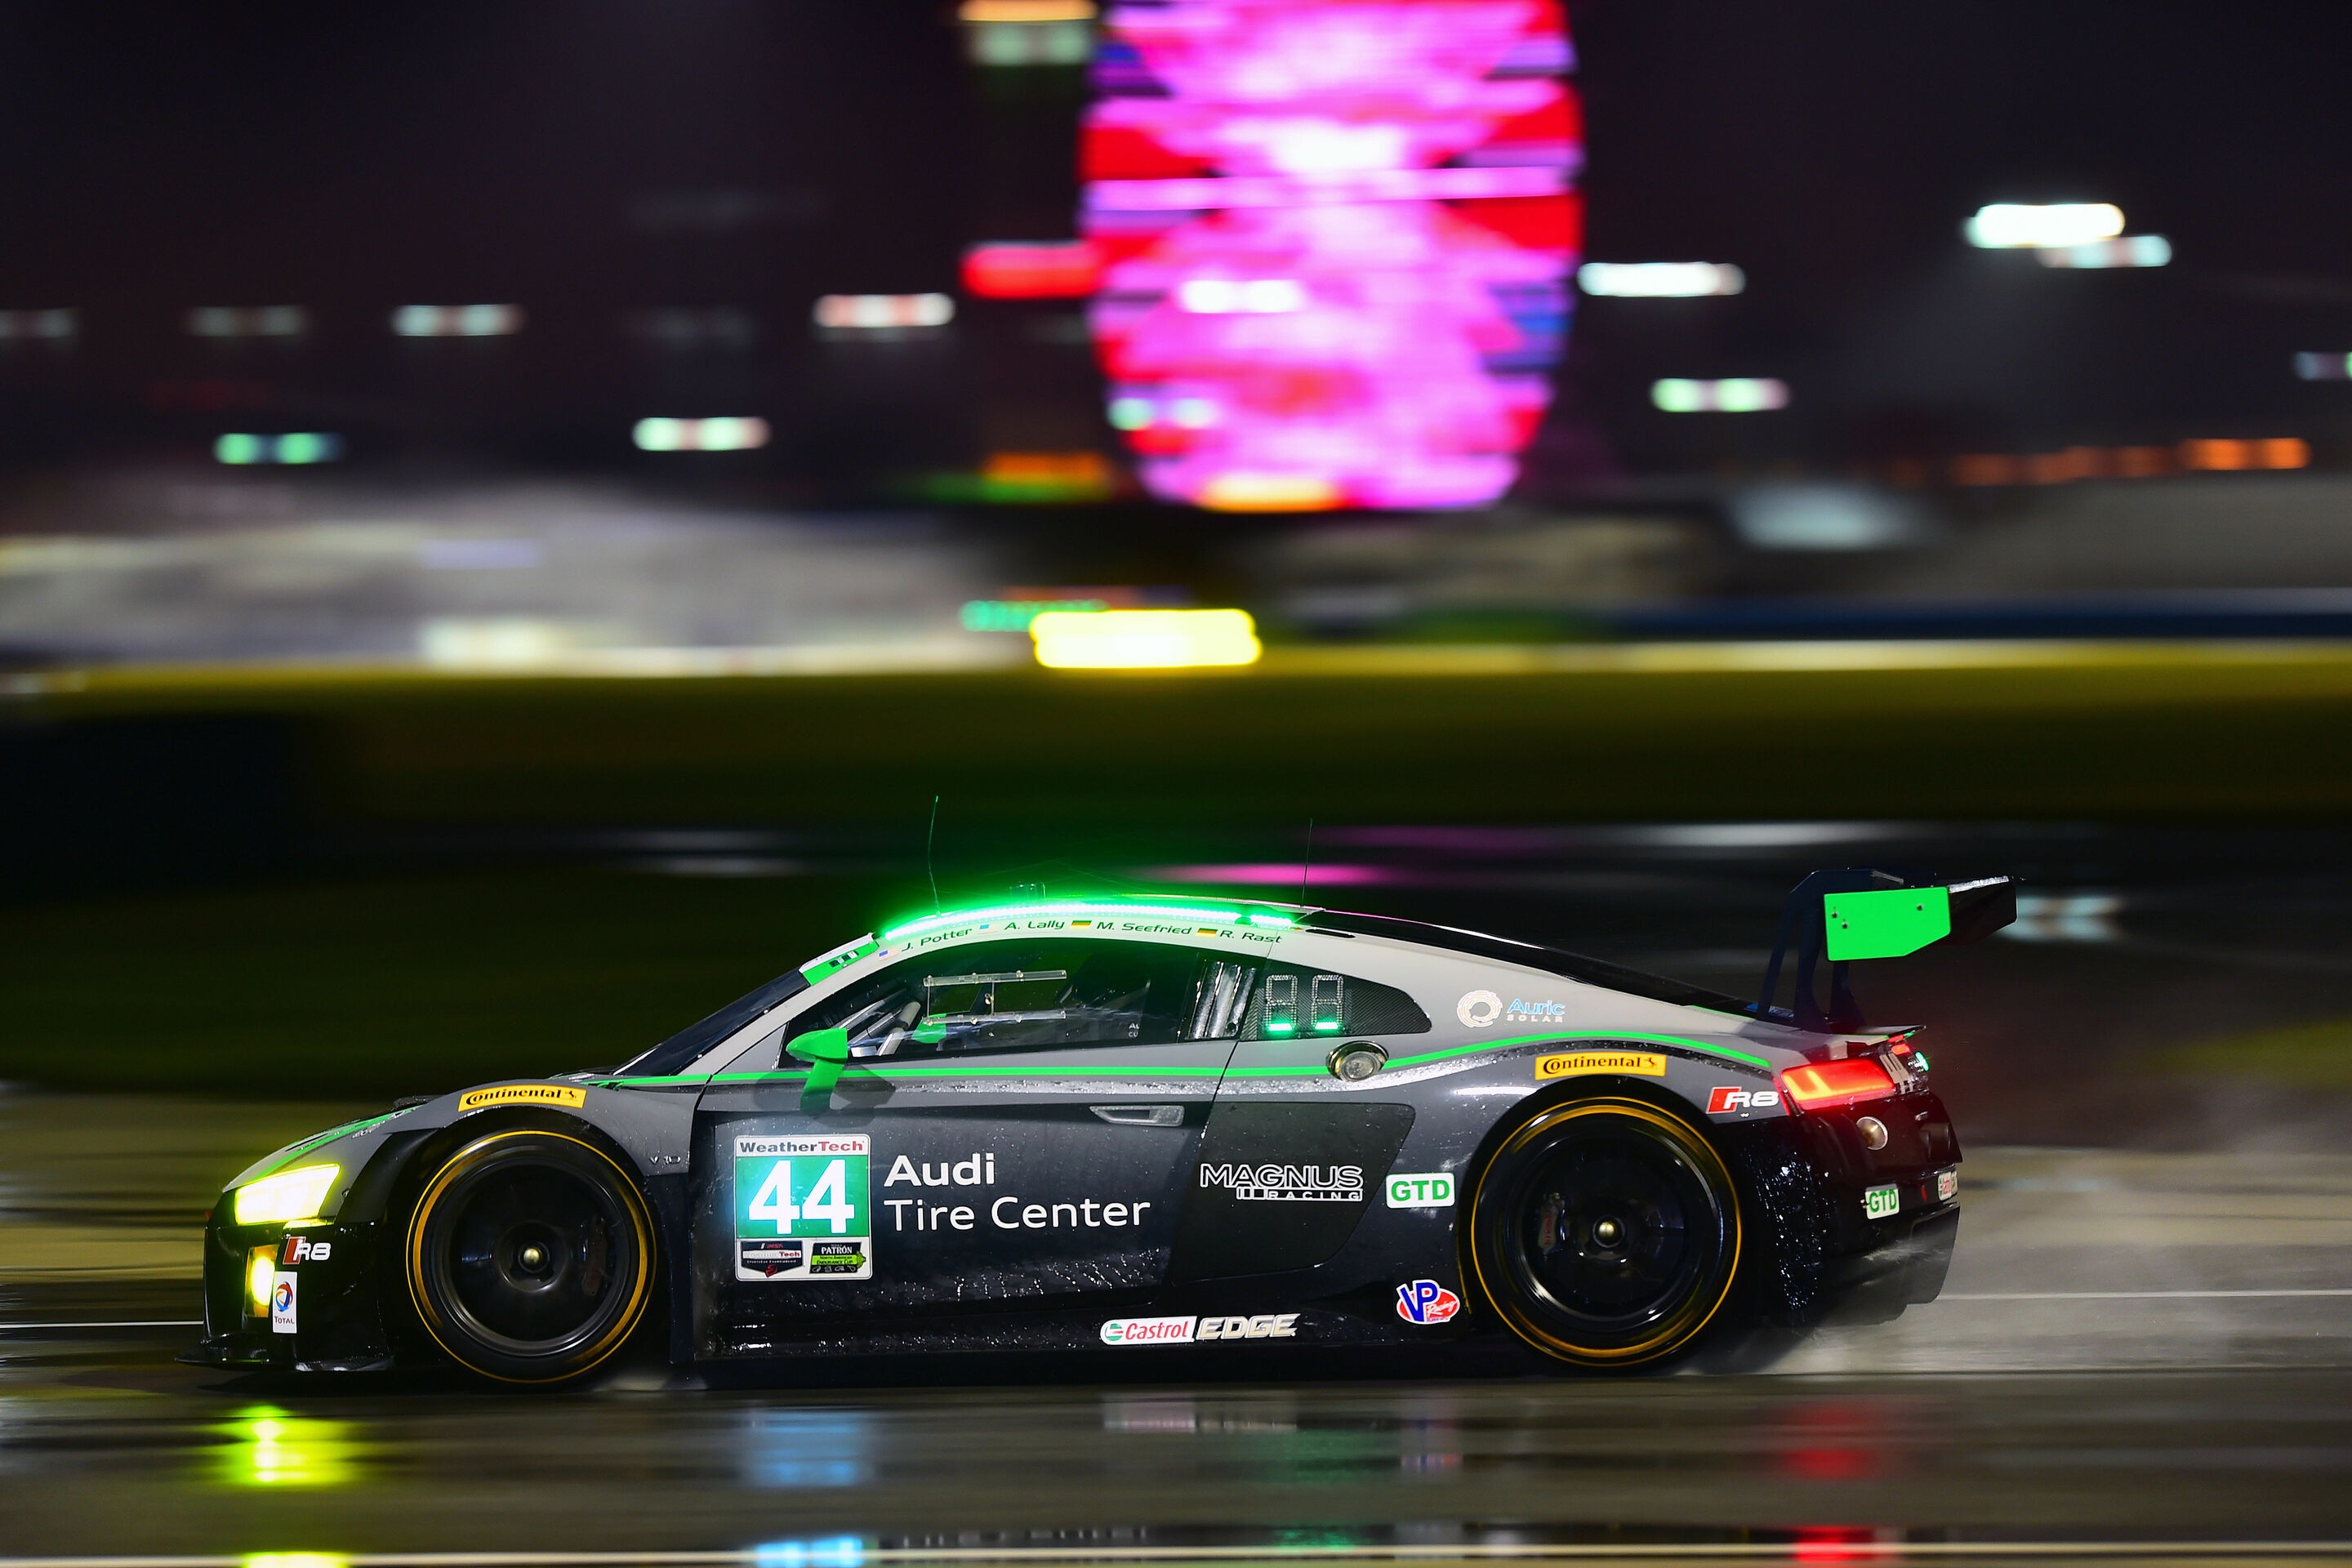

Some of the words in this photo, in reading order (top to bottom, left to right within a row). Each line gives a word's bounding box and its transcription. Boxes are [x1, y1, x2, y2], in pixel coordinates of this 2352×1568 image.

[901, 942, 914, 951] J.
[920, 928, 972, 946] Potter
[1004, 921, 1021, 929] A.
[1027, 920, 1065, 929] Lally
[1096, 921, 1115, 930] M.
[1121, 923, 1192, 934] Seefried
[1219, 929, 1235, 938] R.
[1241, 932, 1282, 943] Rast
[1506, 998, 1566, 1016] Auric
[1543, 1056, 1642, 1074] Continental
[466, 1088, 562, 1106] Continental
[1722, 1089, 1780, 1110] R8
[739, 1141, 864, 1152] WeatherTech
[884, 1152, 996, 1187] Audi
[1200, 1164, 1364, 1188] MAGNUS
[748, 1159, 855, 1234] 44
[1268, 1190, 1361, 1200] RACING
[1391, 1179, 1450, 1201] GTD
[1869, 1188, 1897, 1213] GTD
[884, 1198, 975, 1231] Tire
[991, 1196, 1151, 1229] Center
[292, 1241, 332, 1262] R8
[821, 1245, 853, 1254] PATRÓN
[1399, 1281, 1438, 1322] VP
[274, 1316, 295, 1325] TOTAL
[1125, 1321, 1189, 1340] Castrol
[1195, 1313, 1301, 1340] EDGE
